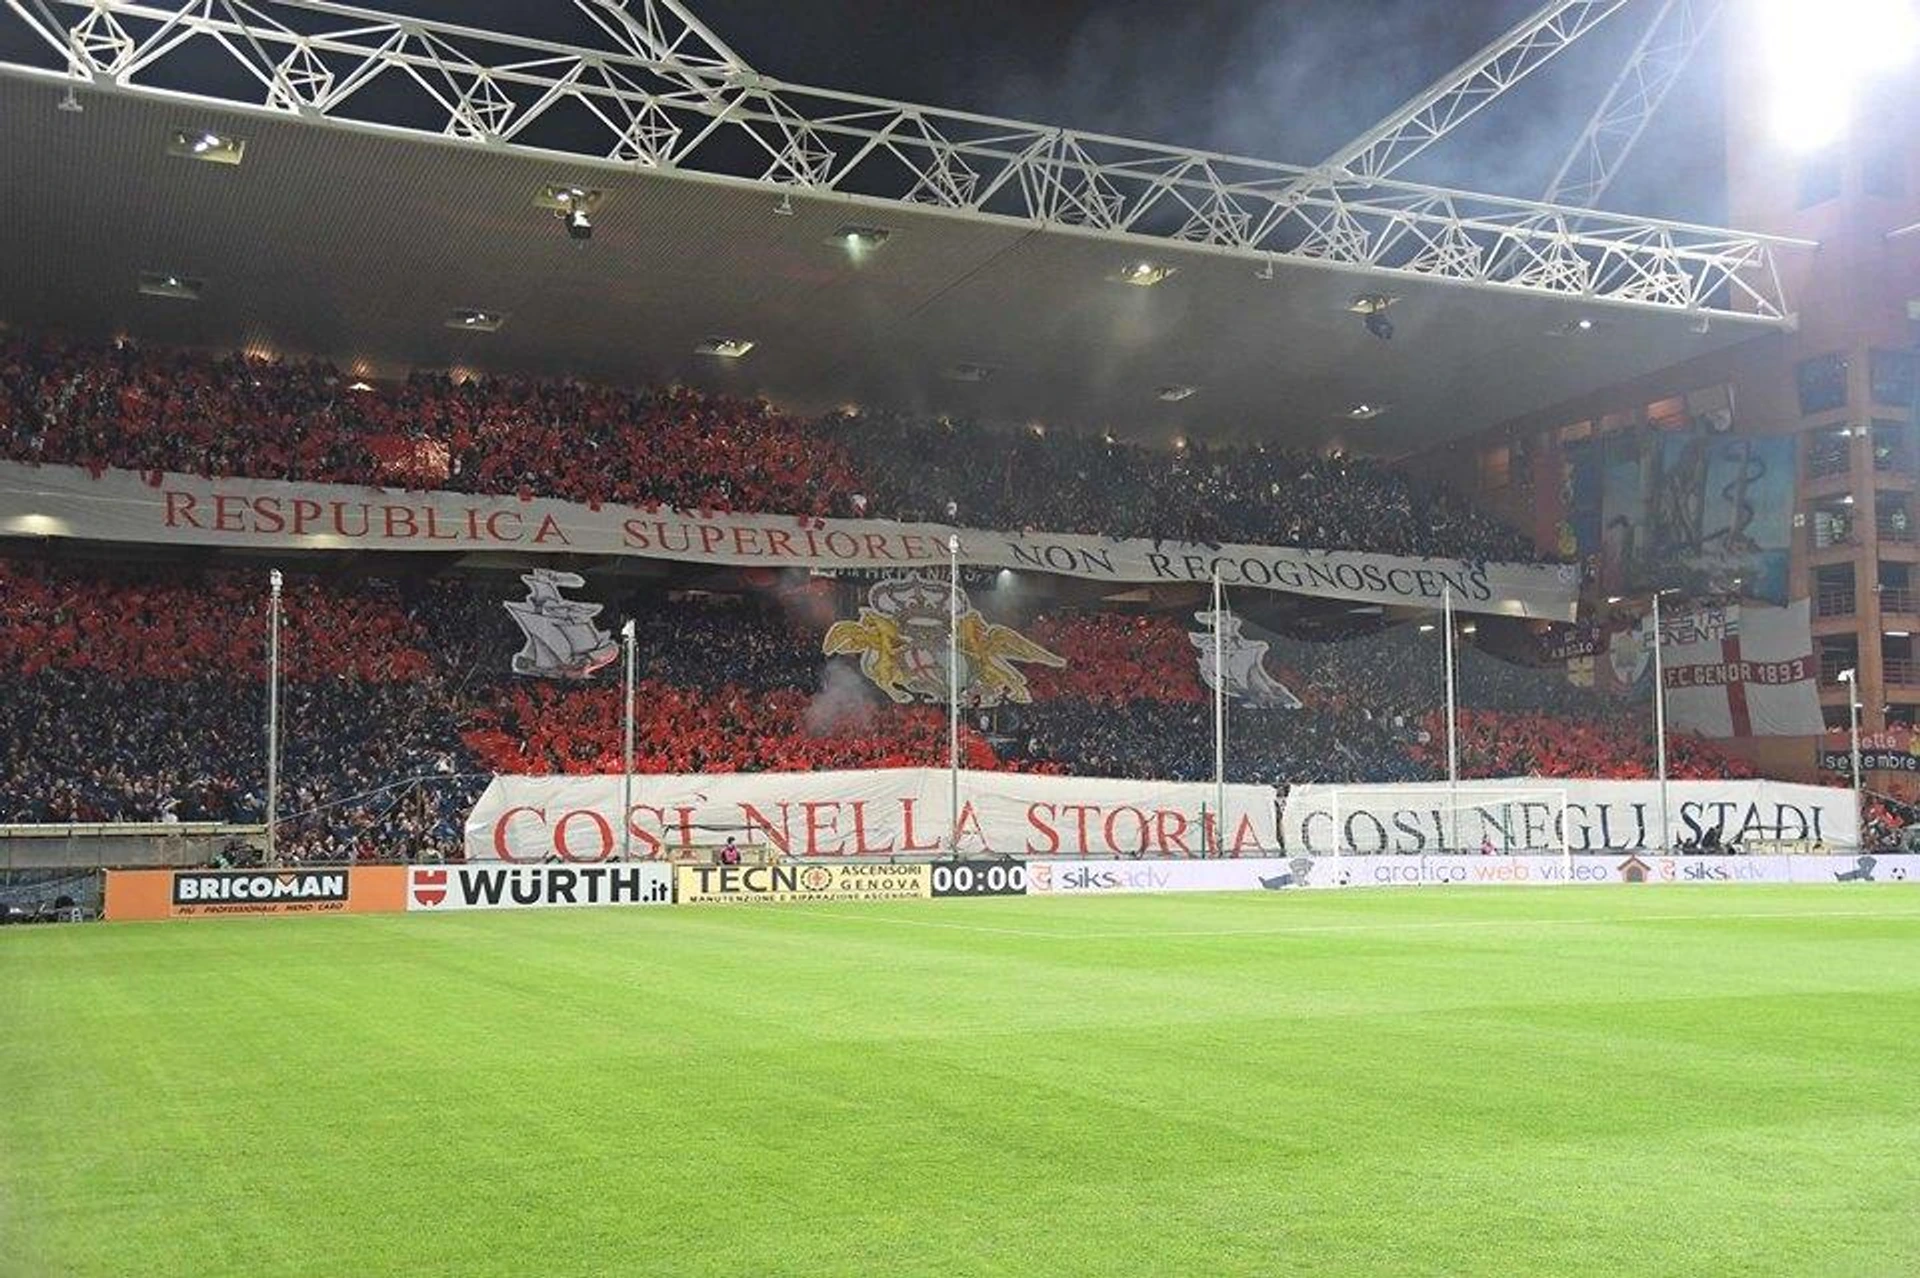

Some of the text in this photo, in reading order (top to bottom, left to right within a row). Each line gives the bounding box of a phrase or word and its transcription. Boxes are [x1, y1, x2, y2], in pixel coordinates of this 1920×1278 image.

[164, 490, 1492, 600] RESPUBLICA SUPERIOREM NON RECOGNOSCENS
[1758, 659, 1804, 684] 1893
[737, 797, 994, 858] NELLA
[1025, 801, 1268, 859] STORIA
[1473, 802, 1647, 856] NEGLI
[1677, 801, 1825, 851] STADI
[840, 865, 922, 876] ASCENSORI
[932, 866, 1027, 891] 00:00
[1374, 856, 1467, 883] grafica
[1475, 858, 1530, 881] web
[179, 875, 344, 900] BRICOMAN
[840, 878, 921, 891] GENOVA
